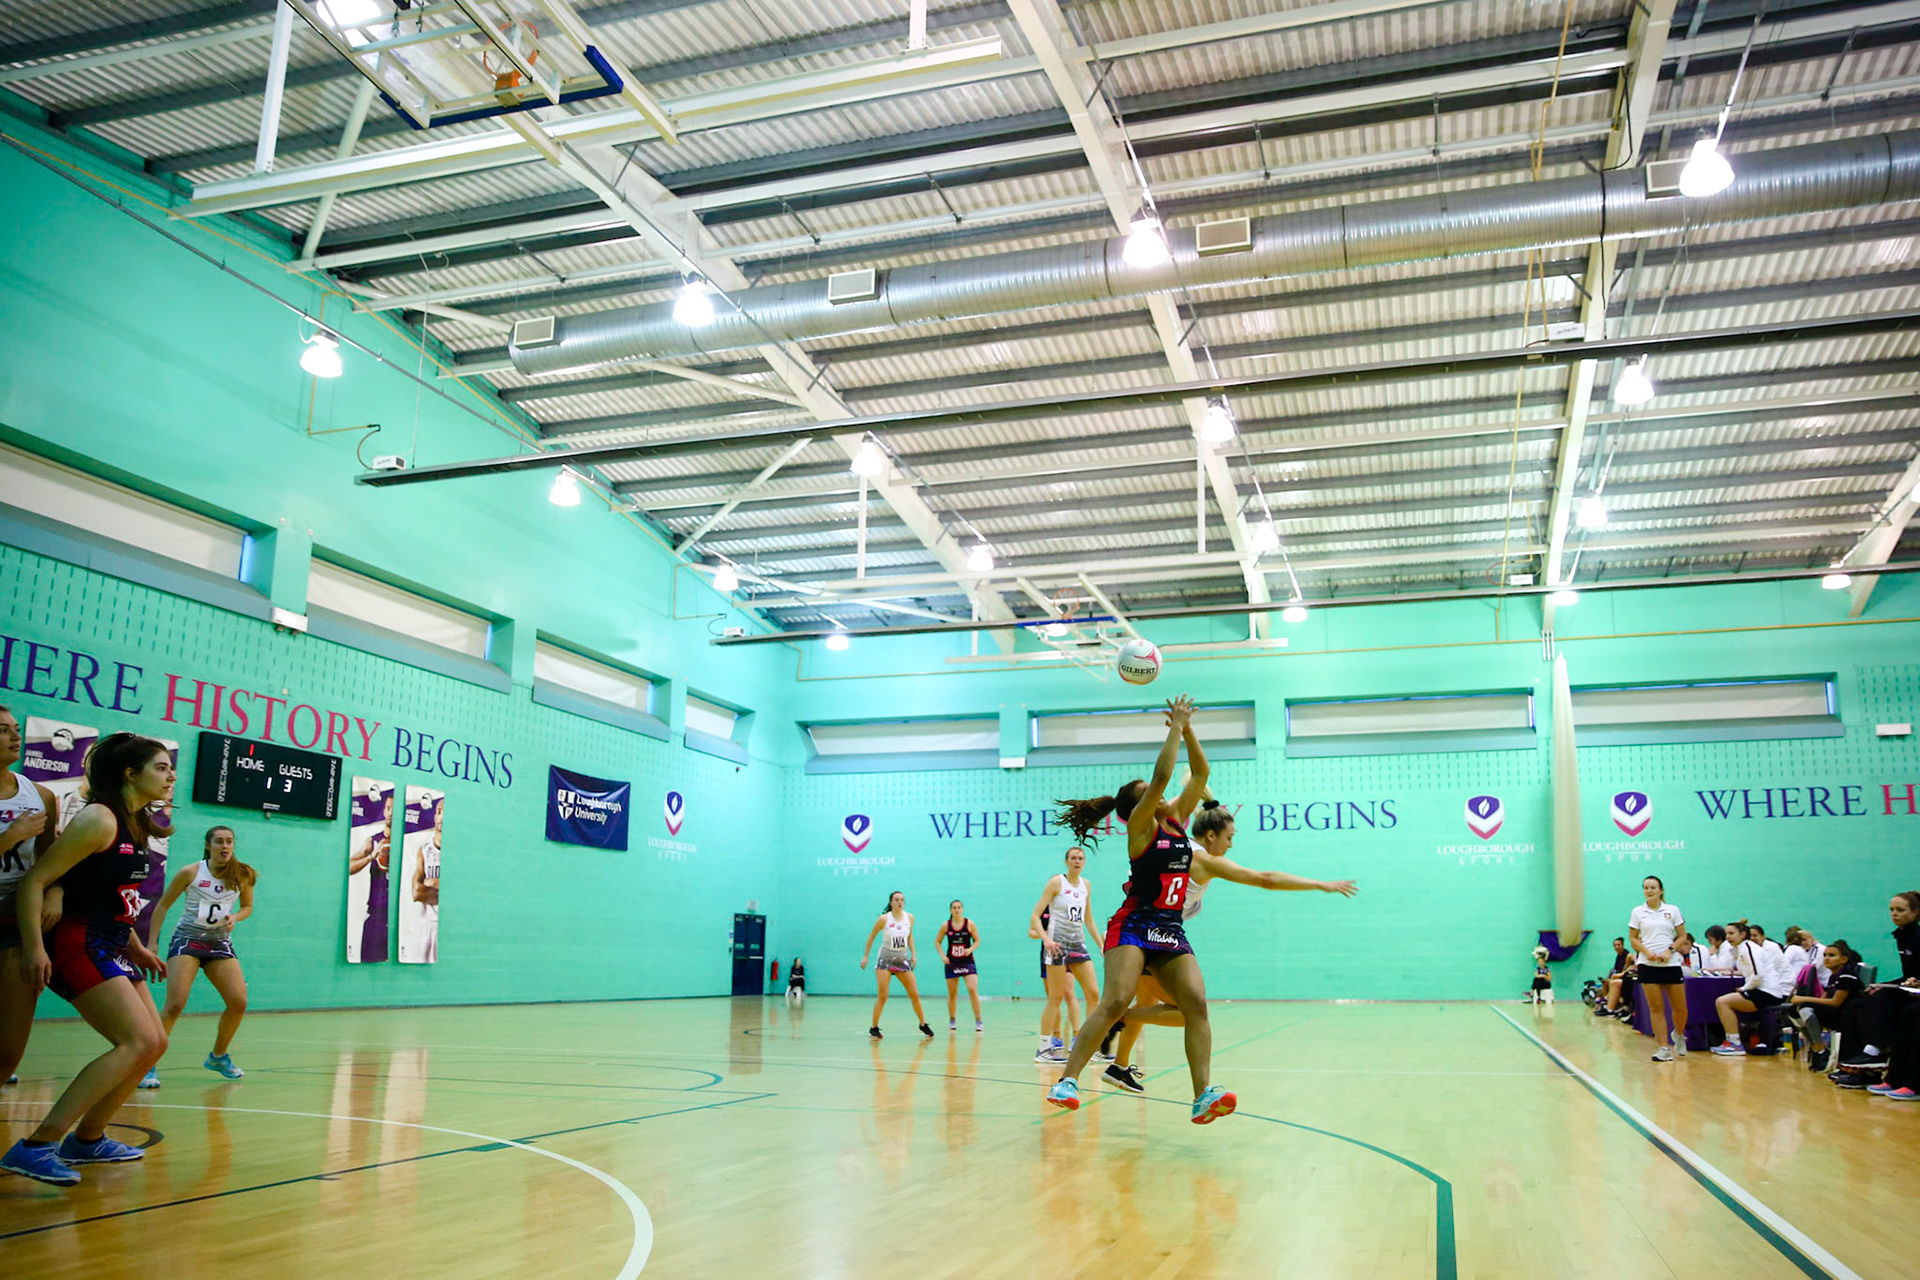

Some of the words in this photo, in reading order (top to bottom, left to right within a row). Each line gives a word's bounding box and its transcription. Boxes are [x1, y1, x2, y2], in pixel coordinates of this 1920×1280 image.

[1121, 664, 1156, 675] GILBERT
[160, 673, 382, 762] HISTORY
[391, 726, 514, 789] BEGINS
[24, 756, 70, 774] ANDERSON
[236, 756, 266, 773] HOME
[279, 763, 314, 781] GUESTS
[283, 778, 294, 794] 3
[576, 794, 623, 815] Loughborough
[1695, 784, 1868, 820] WHERE
[574, 806, 608, 826] University
[929, 808, 1060, 840] WHERE
[1257, 799, 1398, 832] BEGINS
[1437, 843, 1535, 856] LOUGHBOROUGH
[1583, 840, 1685, 852] LOUGHBOROUGH
[1458, 855, 1515, 866] SPORT
[1605, 852, 1664, 863] SPORT
[1165, 876, 1183, 906] C
[206, 903, 221, 924] C
[892, 936, 906, 949] WA
[1147, 927, 1179, 949] Vitality
